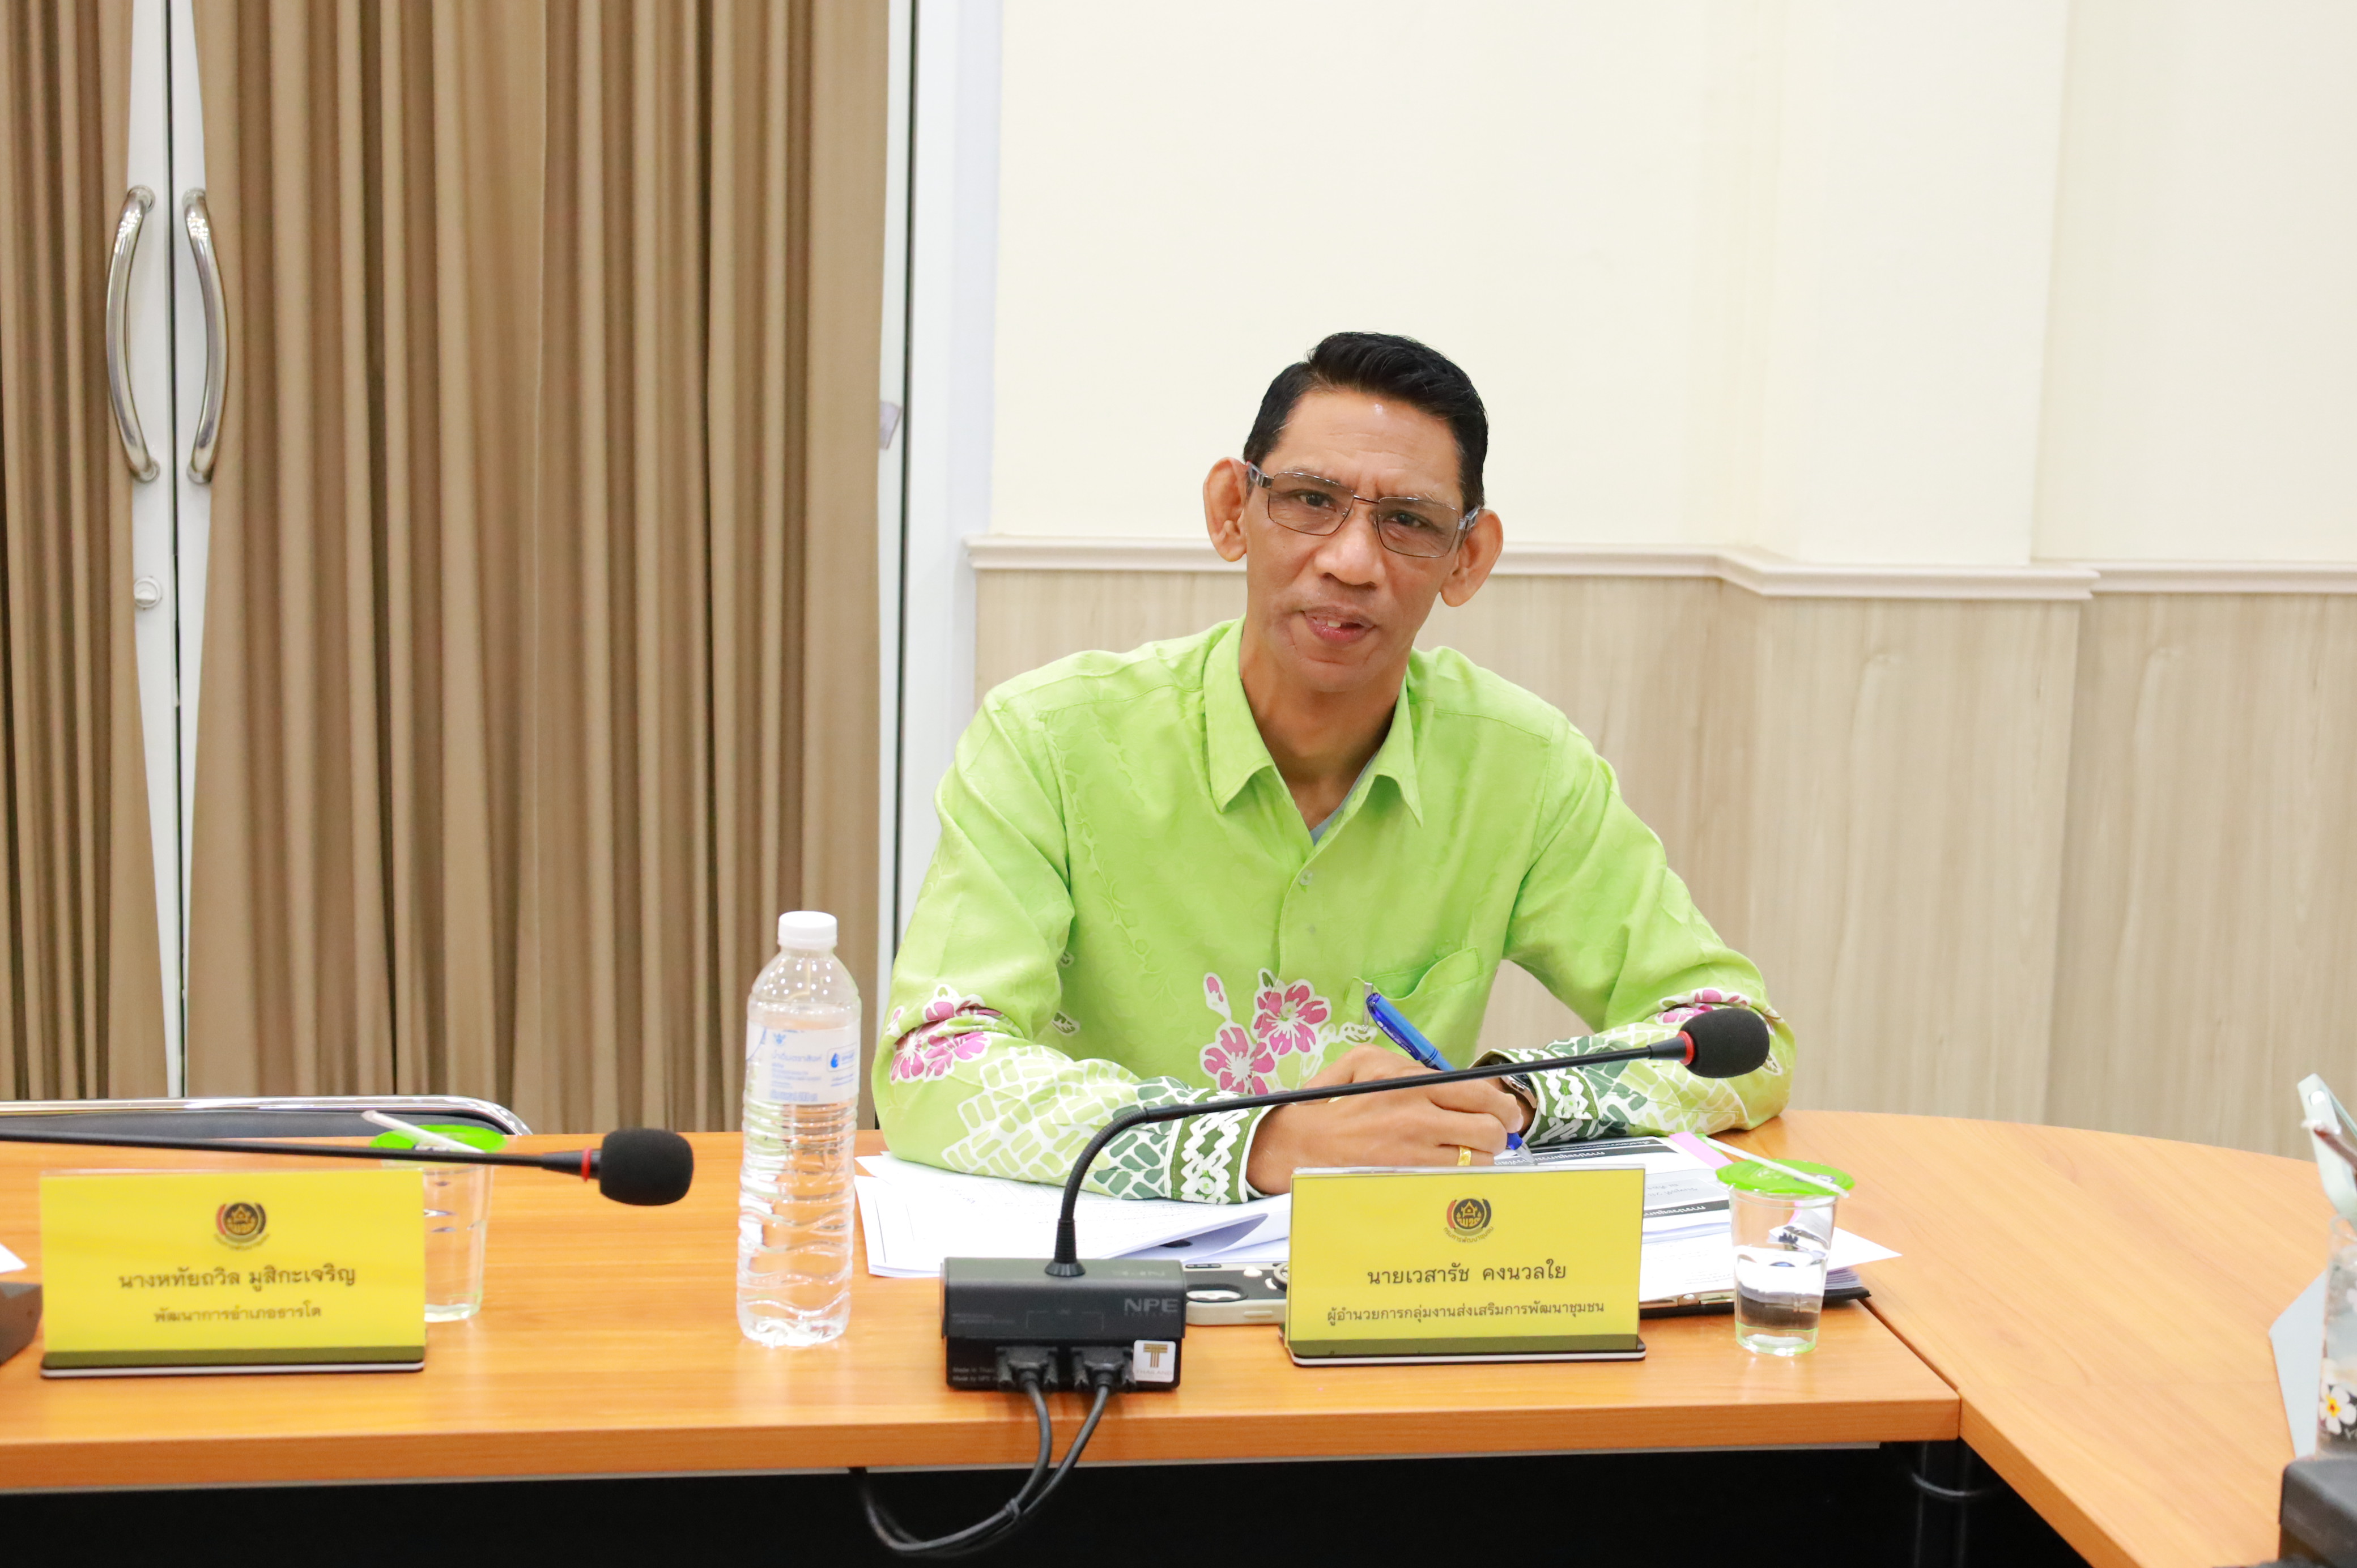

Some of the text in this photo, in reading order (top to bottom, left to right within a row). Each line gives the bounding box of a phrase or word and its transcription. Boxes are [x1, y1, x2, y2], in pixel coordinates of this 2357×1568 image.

[1443, 1226, 1494, 1243] กรมการพัฒนาชุมชน
[118, 1263, 356, 1292] นางหทัยถวิล มูสิกะเจริญ
[1367, 1258, 1567, 1284] นายเวสารัช คงนวลใย
[1124, 1297, 1179, 1313] NPE
[1327, 1300, 1605, 1326] ผู้อำนวยการกลุ่มงานส่งเสริมการพัฒนาชุมชน
